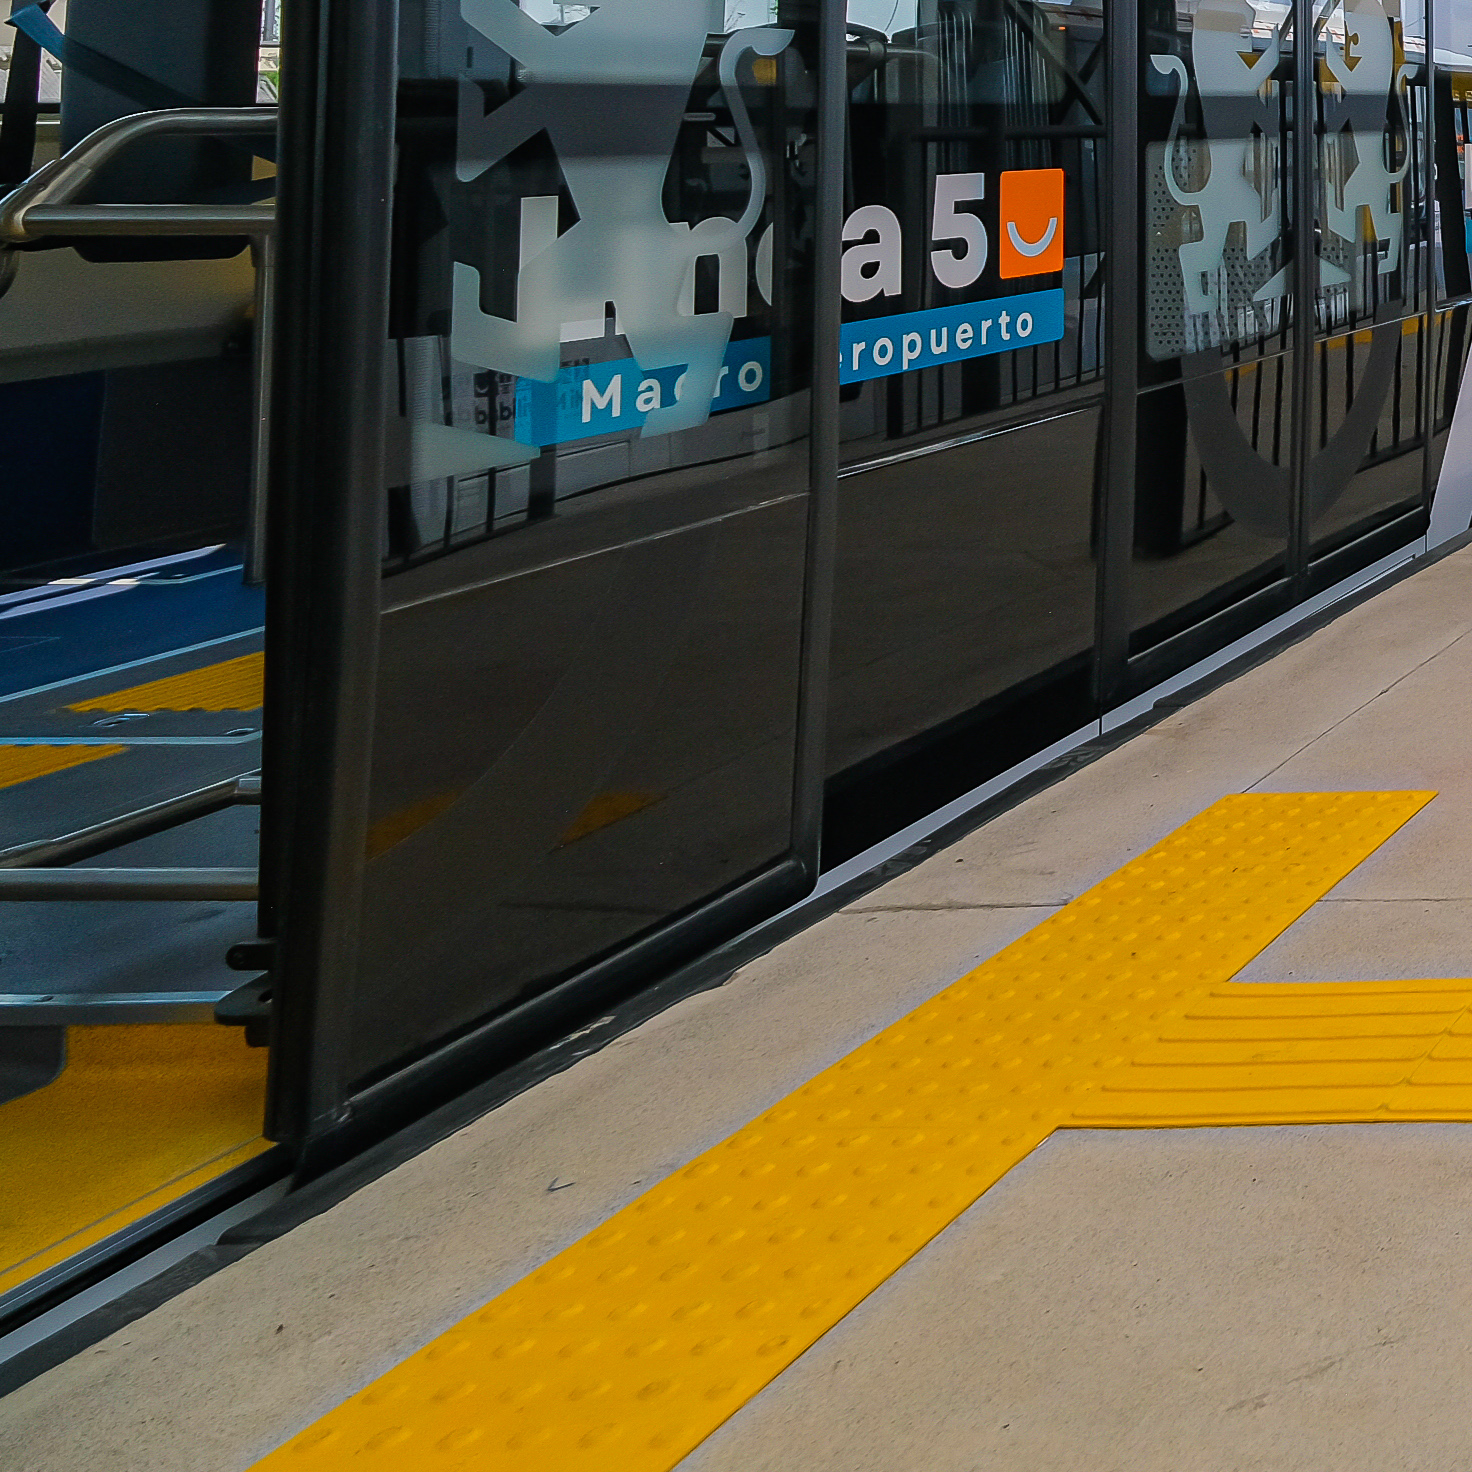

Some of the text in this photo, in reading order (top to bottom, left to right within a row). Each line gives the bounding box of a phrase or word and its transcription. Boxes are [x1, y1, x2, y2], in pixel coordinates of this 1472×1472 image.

[930, 173, 988, 288] 5
[582, 361, 763, 423] Maro
[840, 311, 1033, 370] ropuerto
